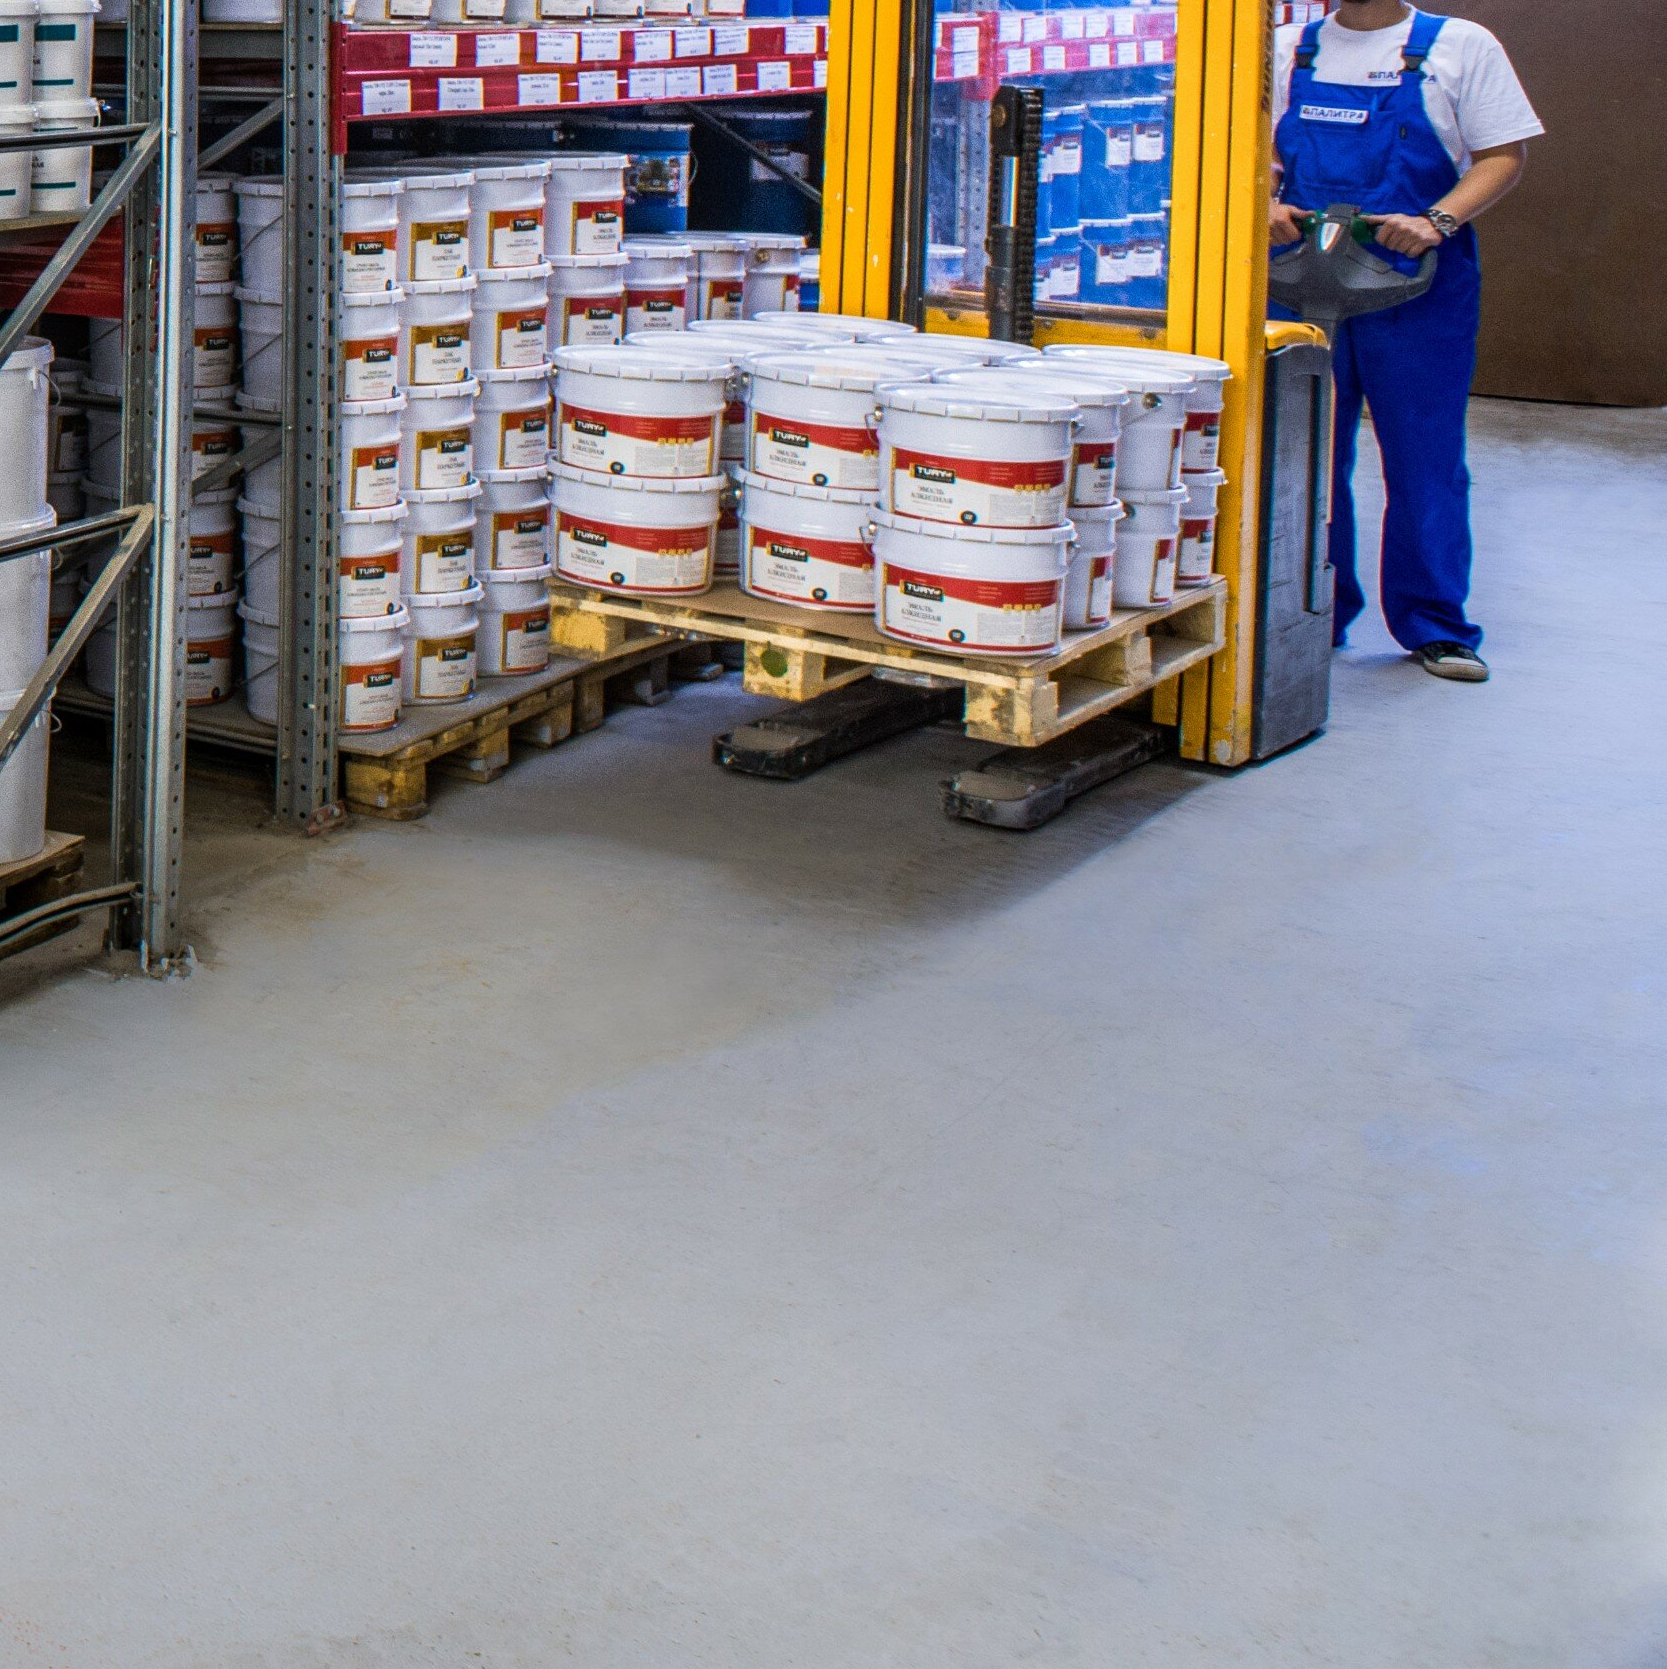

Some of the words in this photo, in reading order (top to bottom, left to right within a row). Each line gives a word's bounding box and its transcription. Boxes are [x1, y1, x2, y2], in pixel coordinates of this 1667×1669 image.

[1310, 108, 1364, 119] ПАЛИТРА
[577, 421, 599, 431] TURY
[776, 431, 799, 441] TURY
[917, 467, 946, 477] TURY
[906, 583, 934, 595] TURY
